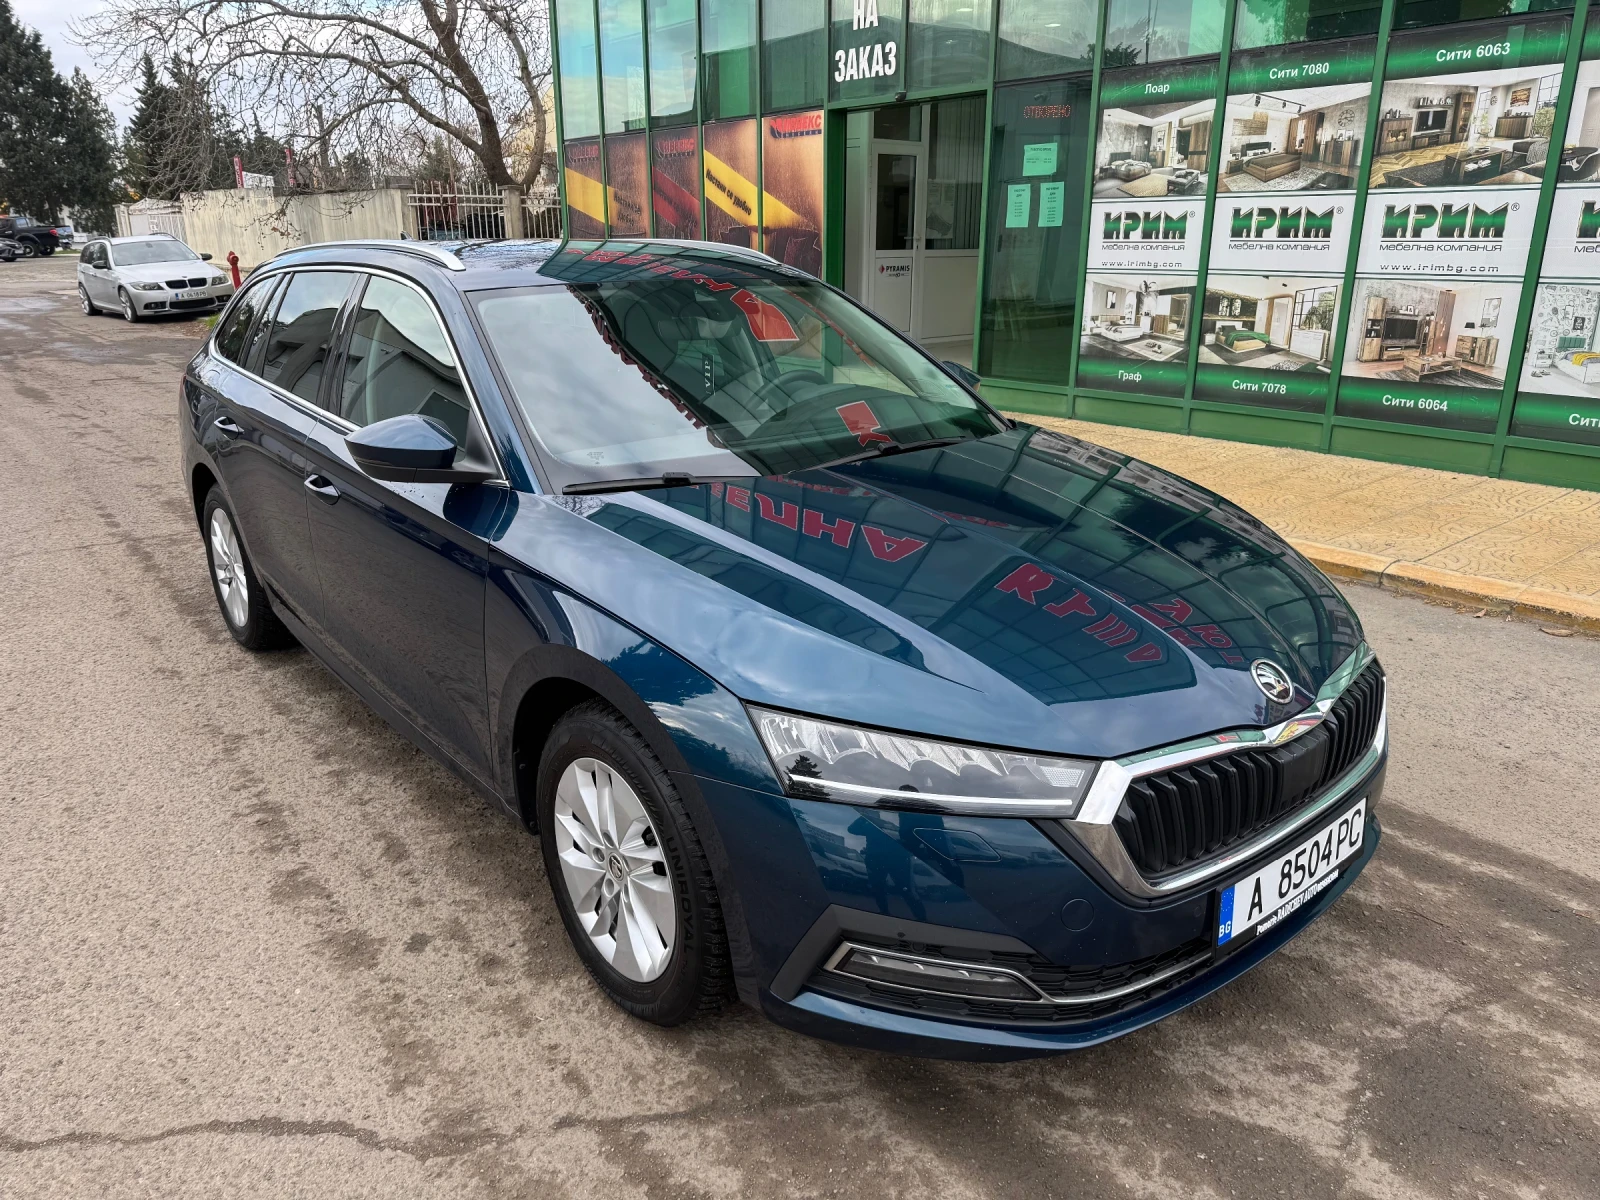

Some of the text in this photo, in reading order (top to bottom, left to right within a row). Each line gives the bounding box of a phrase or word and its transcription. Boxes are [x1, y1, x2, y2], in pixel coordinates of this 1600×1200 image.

[853, 0, 878, 30] НА
[1435, 42, 1511, 62] Сити 6063
[834, 41, 897, 82] ЗАКАЗ
[1269, 62, 1330, 80] Сити 7080
[1144, 83, 1170, 95] Лоар
[1102, 209, 1188, 240] ИРИМ
[1230, 205, 1336, 239] ИРИМ
[1380, 202, 1510, 239] ИРИМ
[1101, 243, 1185, 251] мебелна компания
[1228, 242, 1330, 251] мебелна компания
[1379, 243, 1502, 252] мебелна компания
[1101, 260, 1182, 269] www.irimbg.com
[1380, 263, 1499, 273] www.irimbg.com
[1118, 370, 1142, 382] Граф
[1232, 379, 1287, 394] Сити 7078
[1382, 394, 1448, 412] Сити 6064
[665, 836, 694, 953] UNIROYAL
[1247, 876, 1263, 922] A
[1218, 921, 1231, 938] BG
